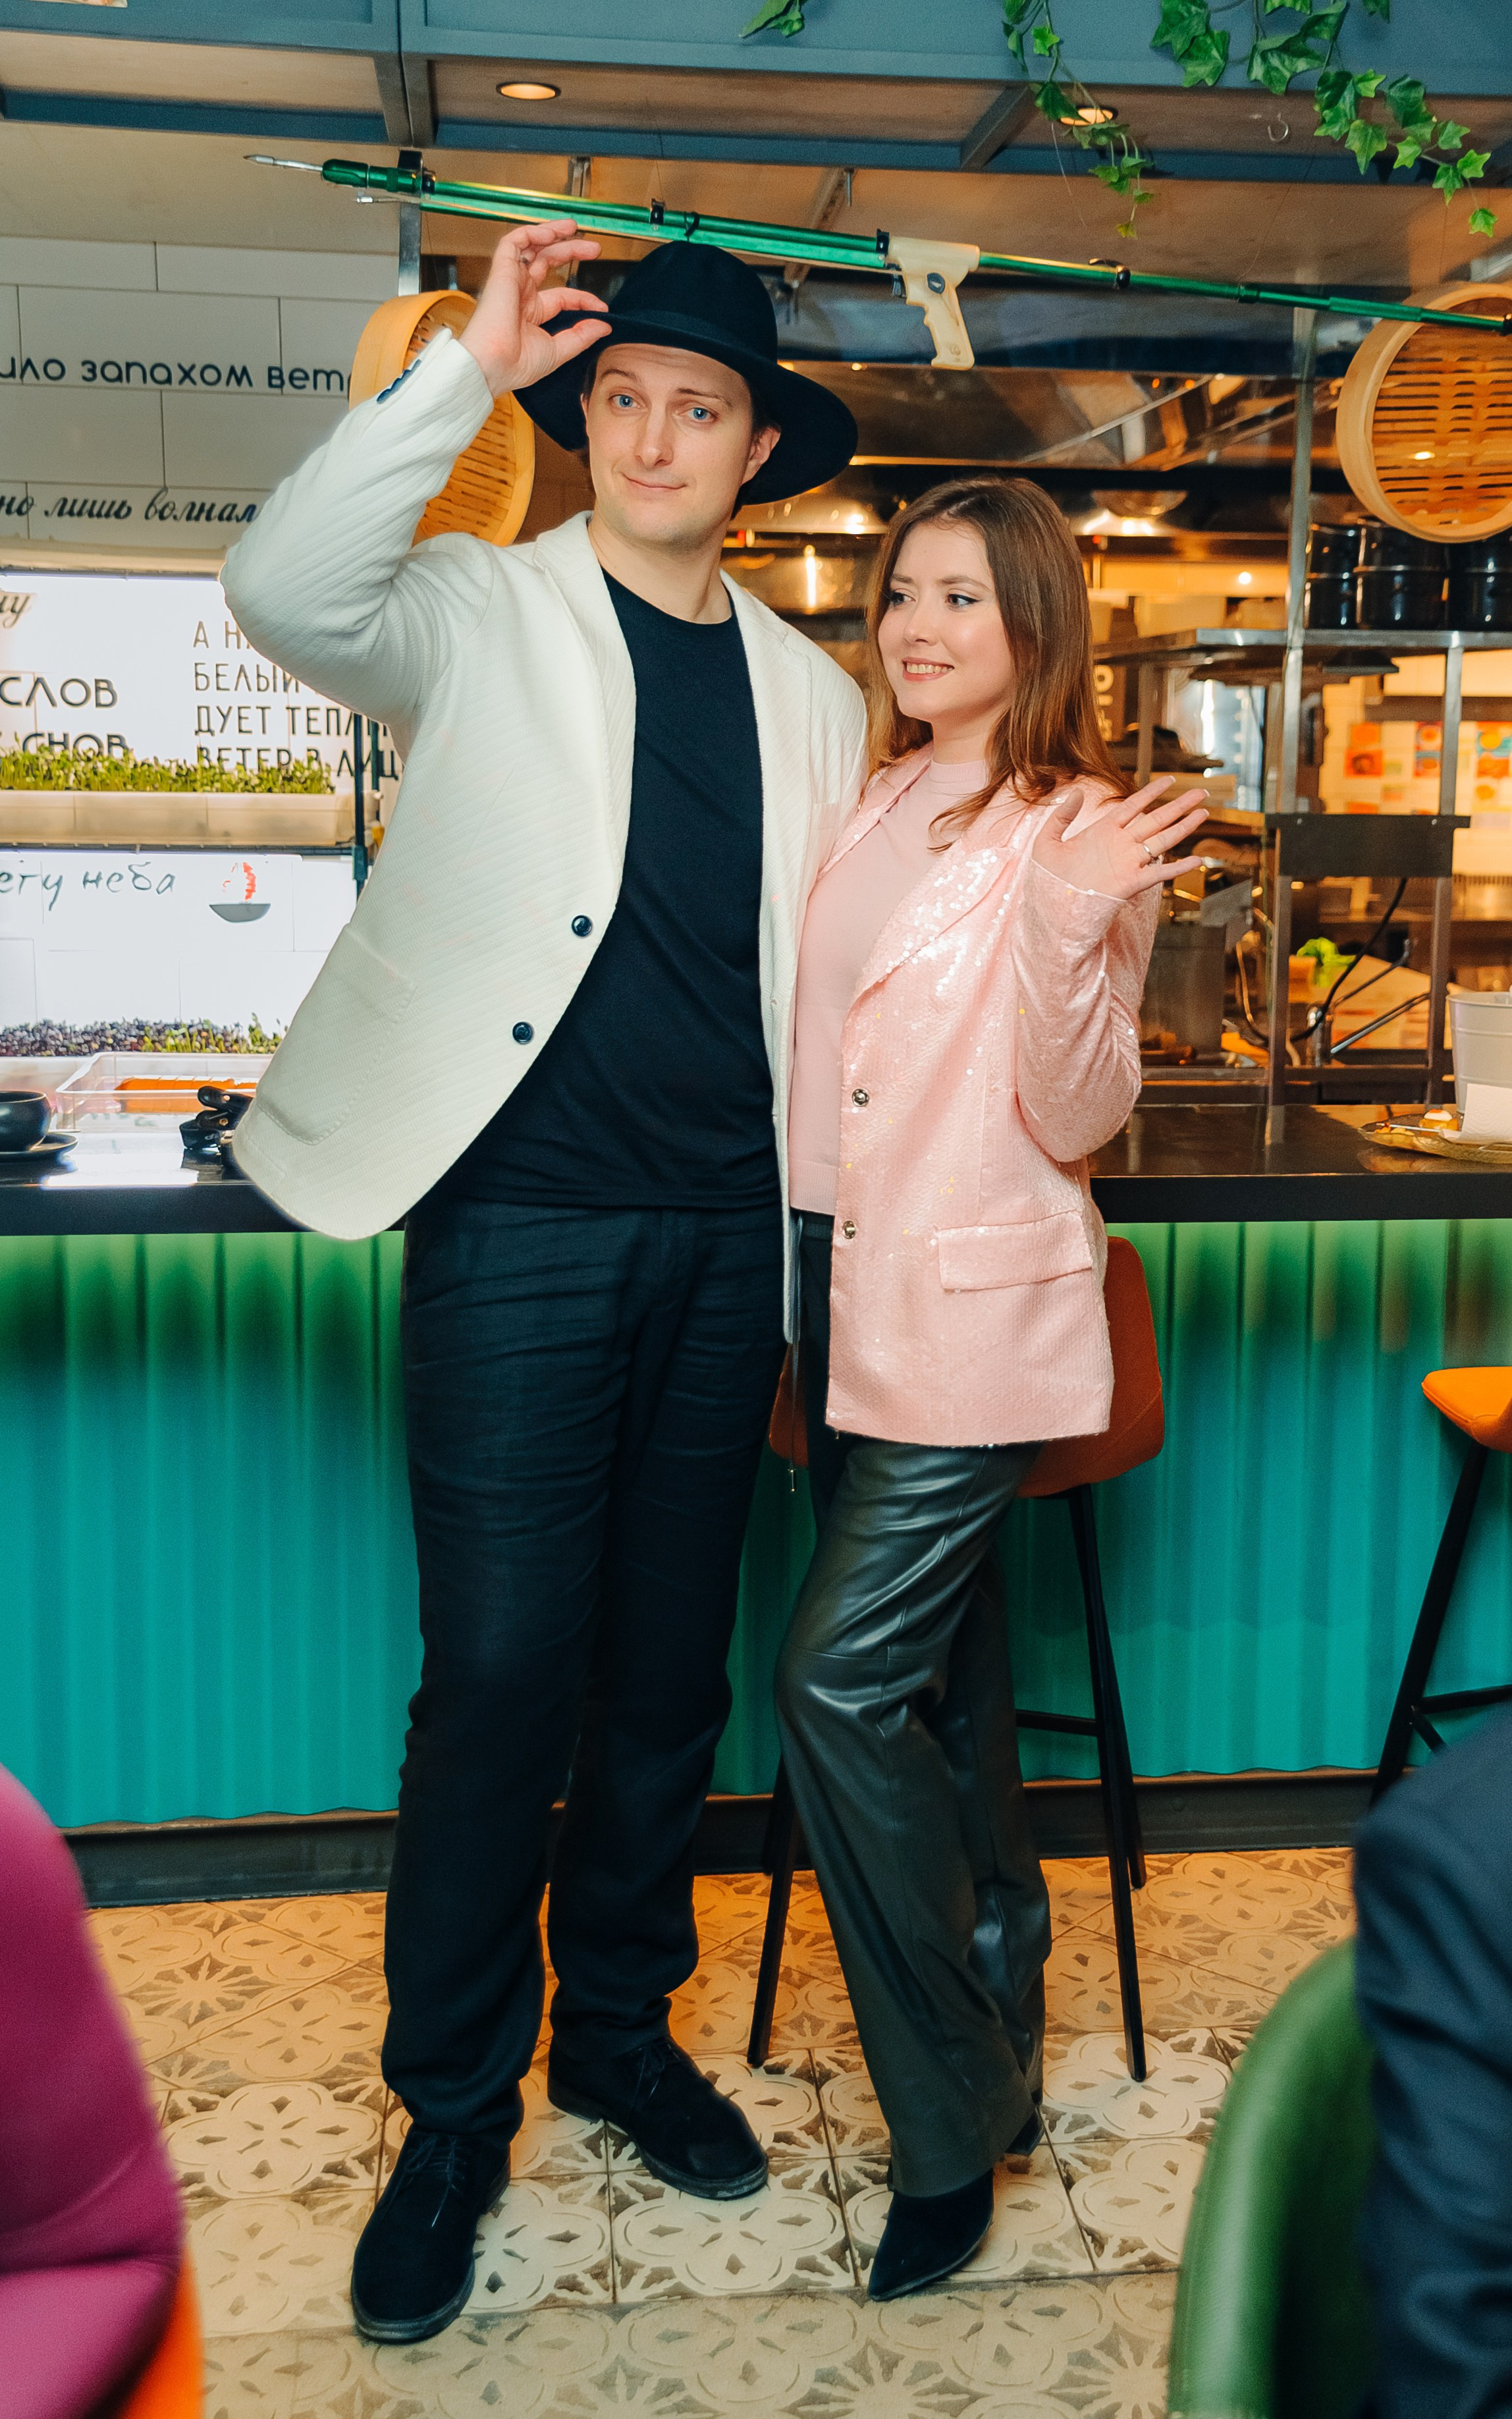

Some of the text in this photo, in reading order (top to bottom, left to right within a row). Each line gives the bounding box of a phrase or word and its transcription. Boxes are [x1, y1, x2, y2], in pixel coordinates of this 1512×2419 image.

[81, 359, 254, 387] запахом
[267, 366, 352, 395] вет
[44, 495, 132, 520] лишь
[193, 621, 252, 649] А Н
[0, 676, 119, 709] СЛОВ
[195, 705, 271, 736] ДУЕТ
[337, 750, 404, 781] ЛЦ
[82, 861, 175, 894] неба
